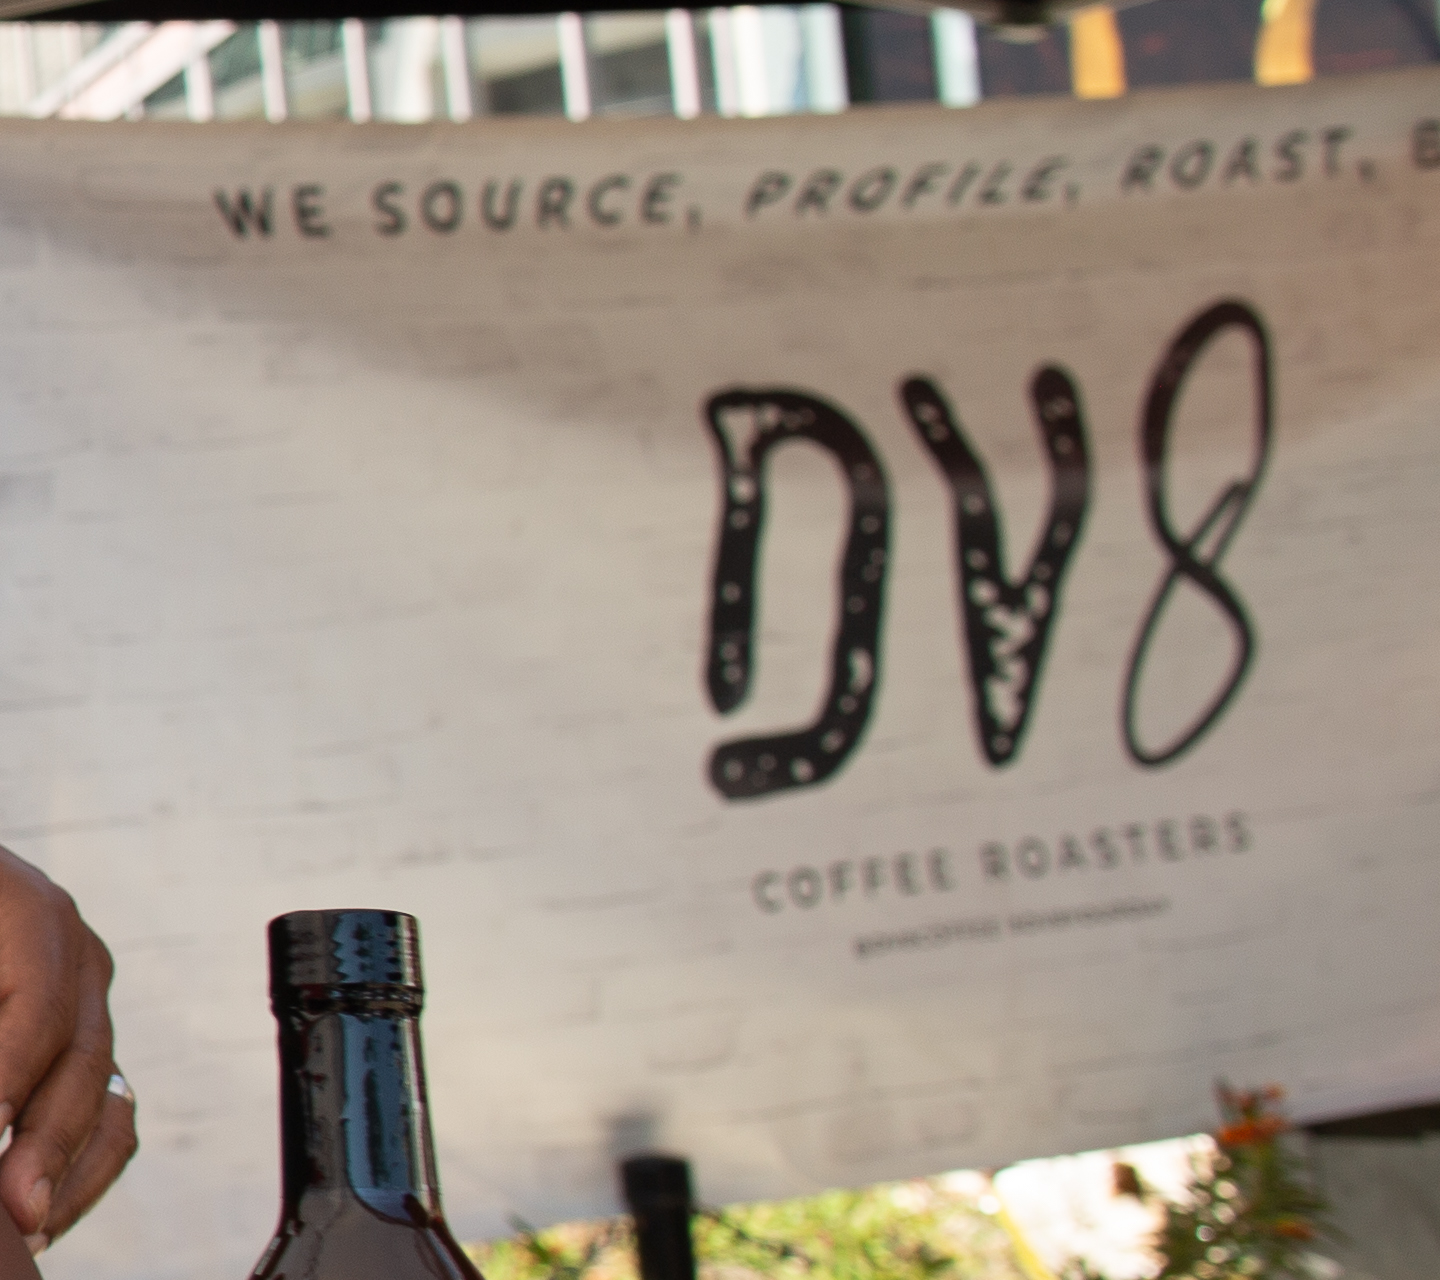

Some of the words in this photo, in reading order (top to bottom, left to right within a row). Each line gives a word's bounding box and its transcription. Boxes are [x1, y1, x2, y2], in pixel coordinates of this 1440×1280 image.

[213, 181, 332, 240] WE
[370, 172, 703, 238] SOURCE,
[743, 154, 1079, 221] PROFILE,
[702, 298, 1272, 802] DV8
[750, 847, 957, 915] COFFEE
[980, 810, 1253, 881] ROASTERS
